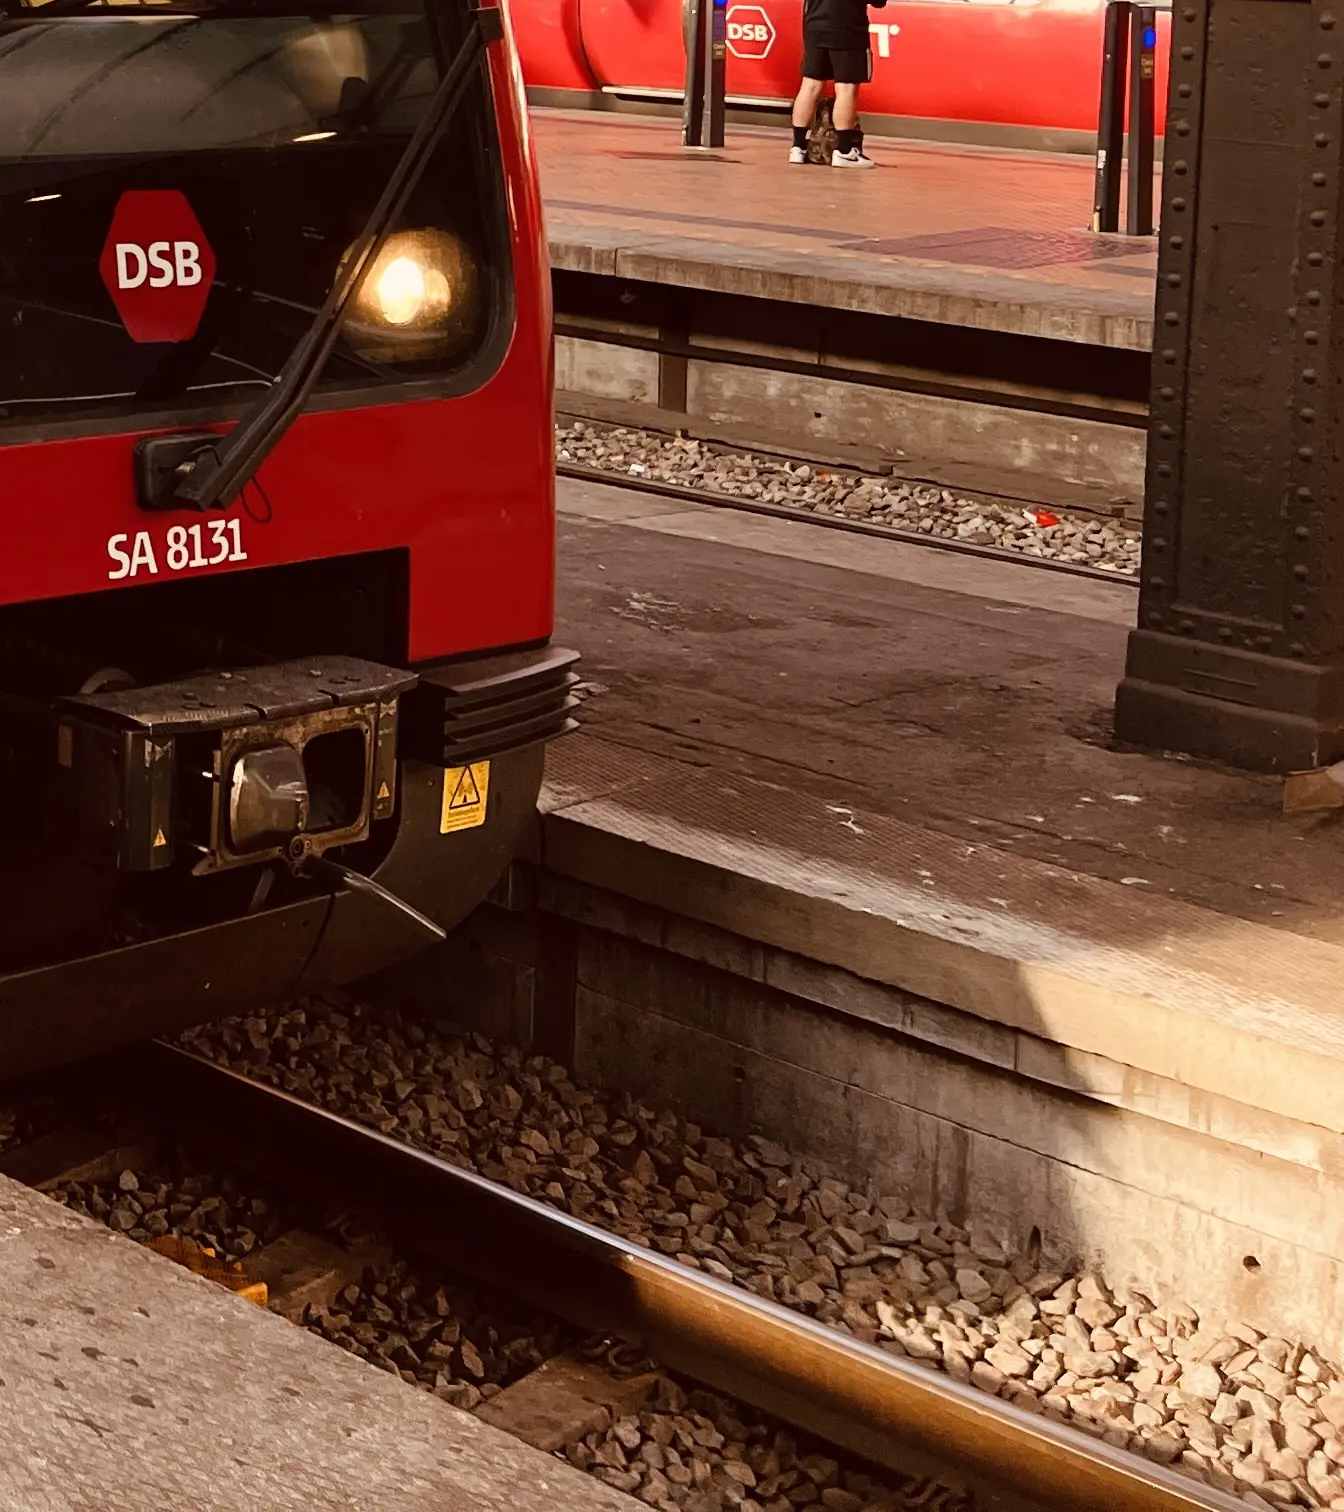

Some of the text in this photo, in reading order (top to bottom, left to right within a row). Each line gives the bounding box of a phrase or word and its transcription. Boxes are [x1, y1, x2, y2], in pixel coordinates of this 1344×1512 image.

[727, 23, 769, 41] DSB
[115, 241, 202, 289] DSB
[107, 518, 248, 580] SA 8131
